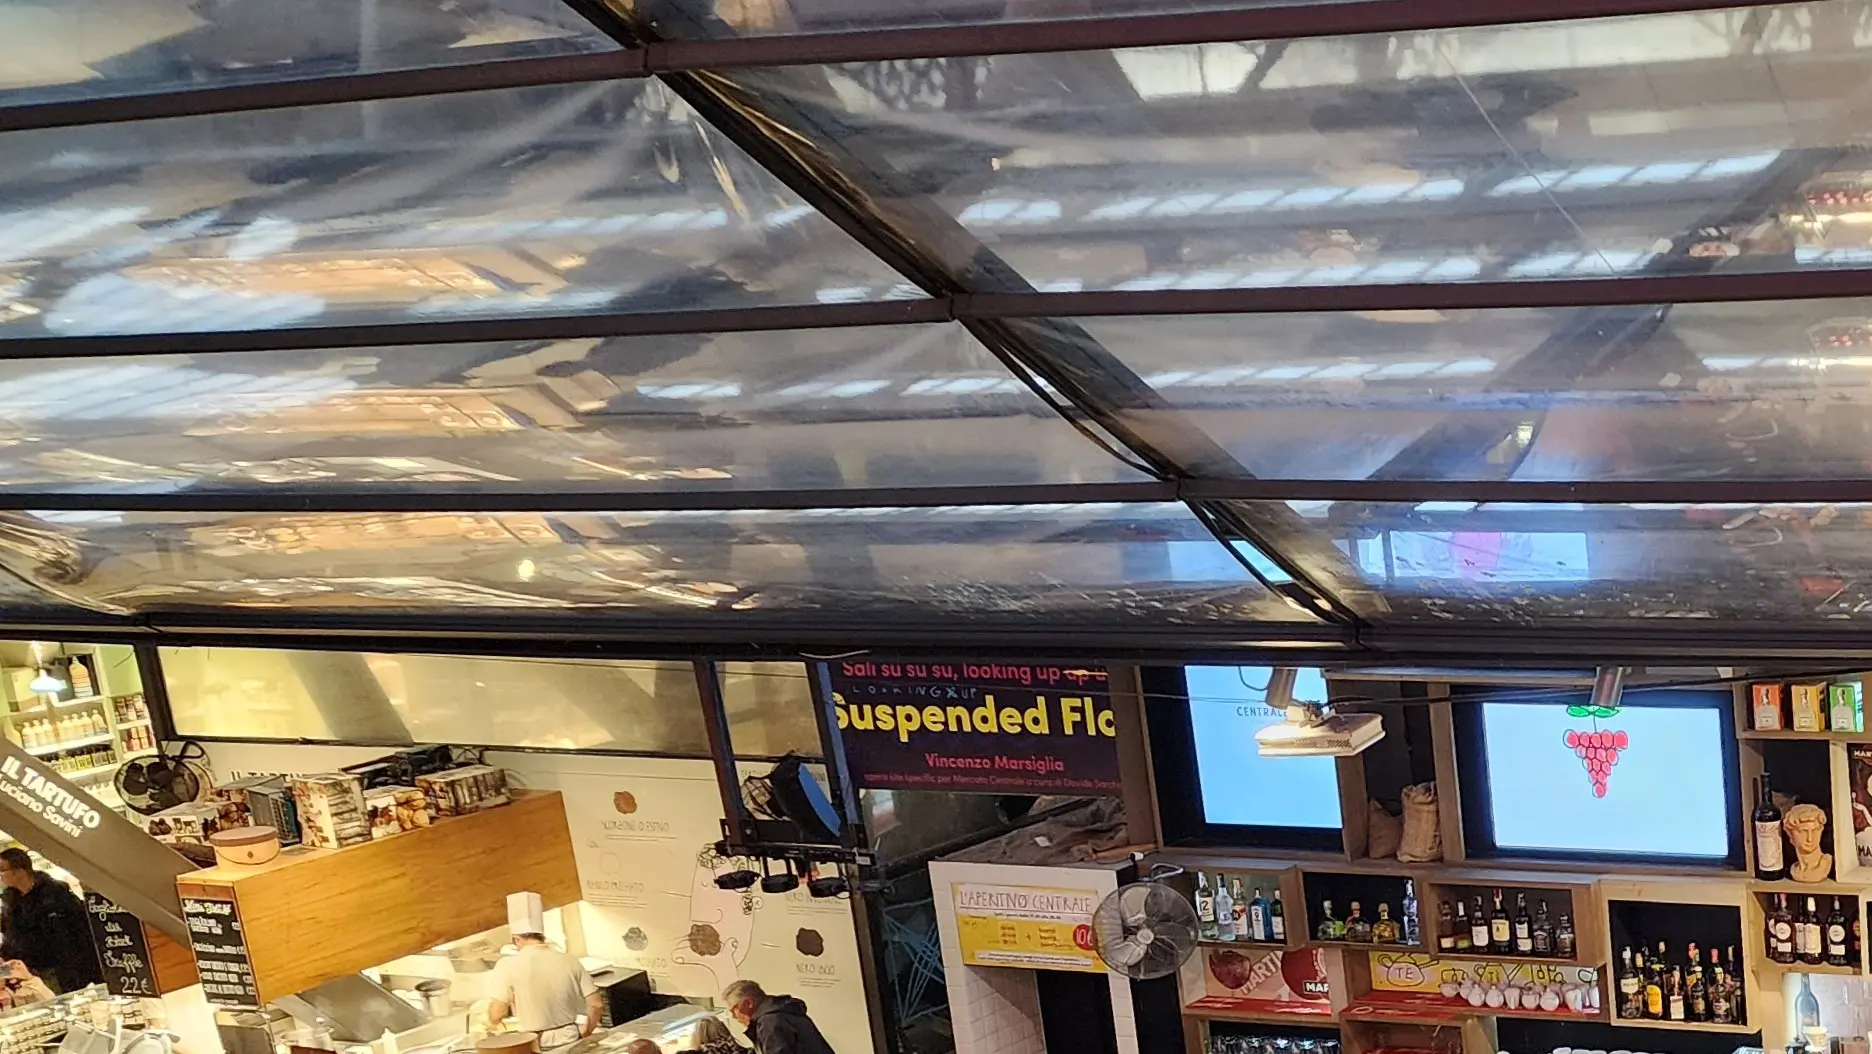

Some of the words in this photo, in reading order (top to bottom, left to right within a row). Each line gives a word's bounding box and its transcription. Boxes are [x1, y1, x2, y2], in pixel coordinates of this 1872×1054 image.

[881, 665, 901, 677] su
[906, 665, 927, 677] su
[963, 663, 1031, 684] looking
[1037, 666, 1060, 685] up
[831, 692, 1050, 743] Suspended
[1, 756, 20, 780] IL
[925, 753, 990, 770] Vincenzo
[994, 755, 1065, 775] Marsiglia
[24, 767, 101, 829] TARTUFO
[120, 976, 153, 995] 22€
